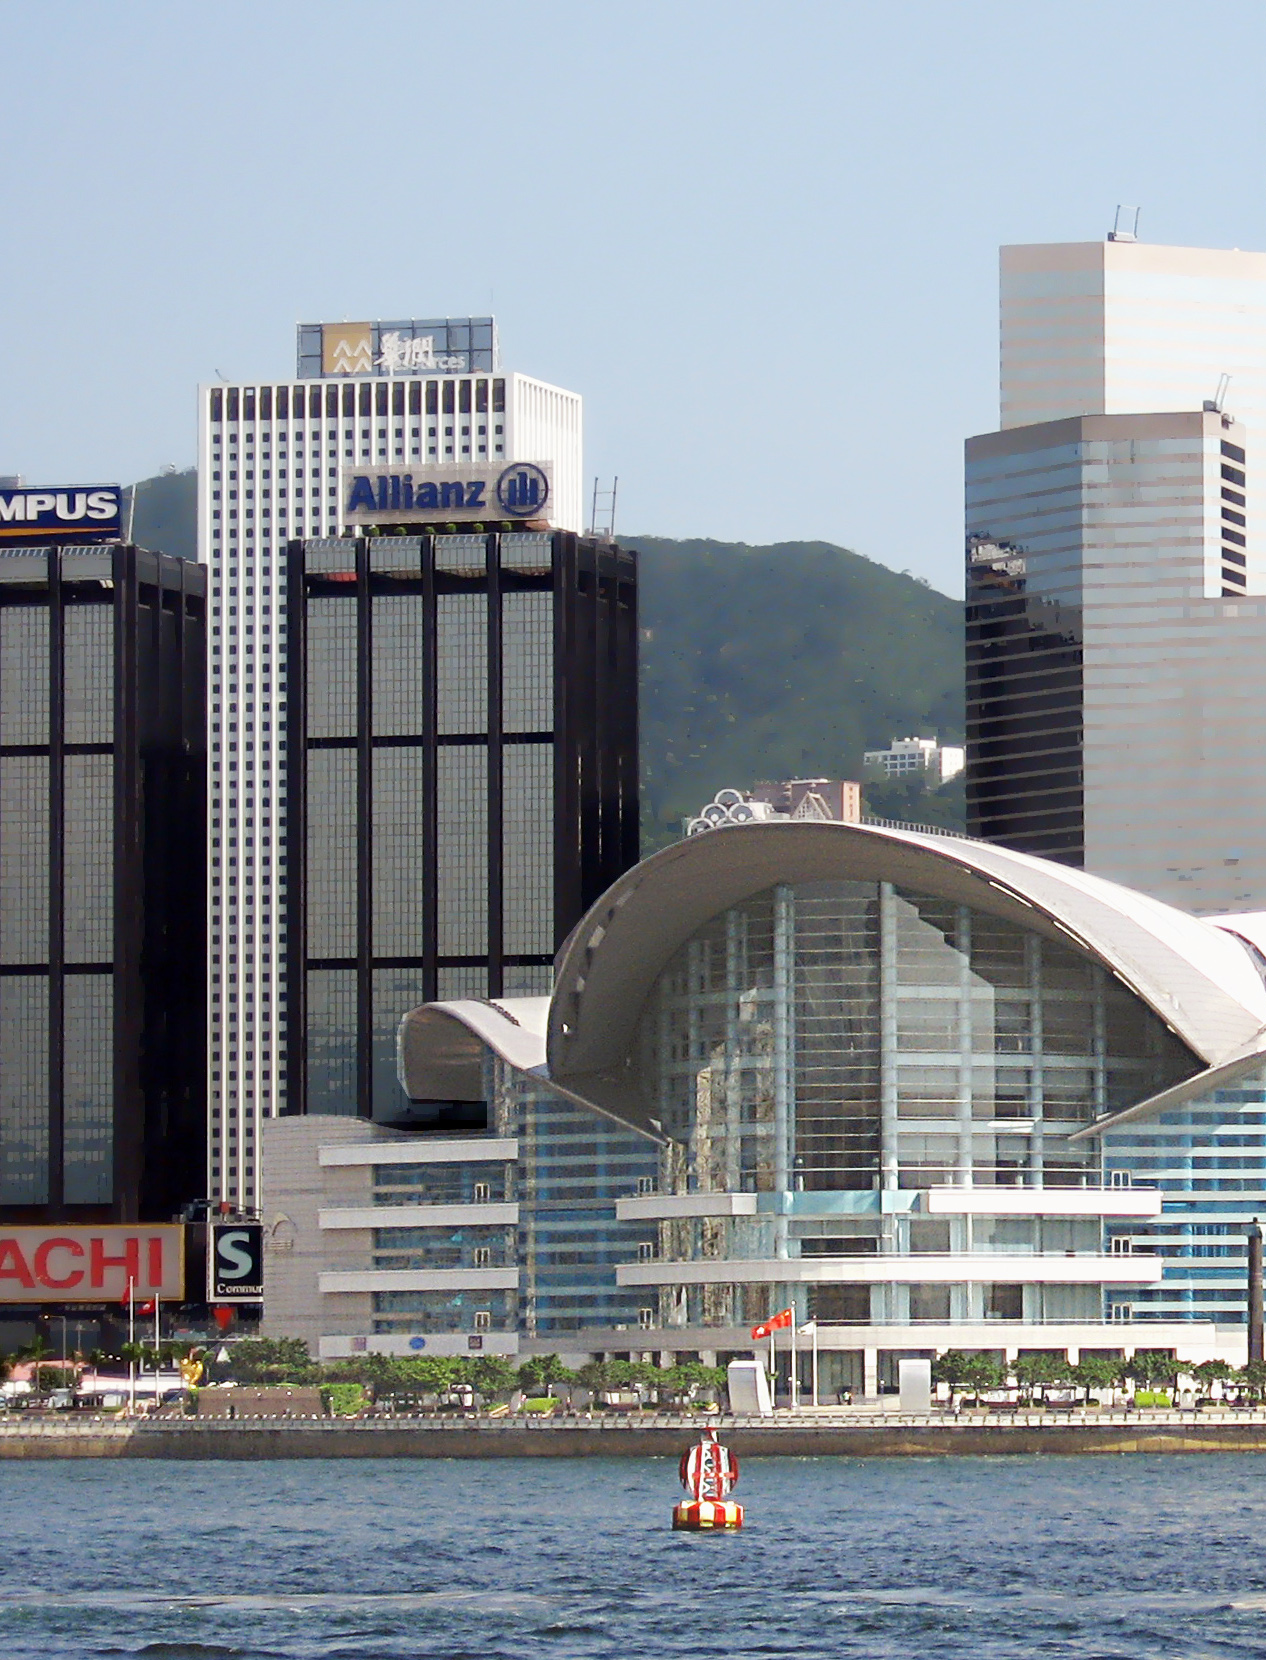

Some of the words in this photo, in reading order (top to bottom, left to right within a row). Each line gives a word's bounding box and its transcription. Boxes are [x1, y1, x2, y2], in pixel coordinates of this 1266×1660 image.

[0, 491, 118, 521] MPUS
[348, 473, 486, 512] Allianz
[0, 1237, 163, 1289] ACHI
[217, 1231, 253, 1279] S
